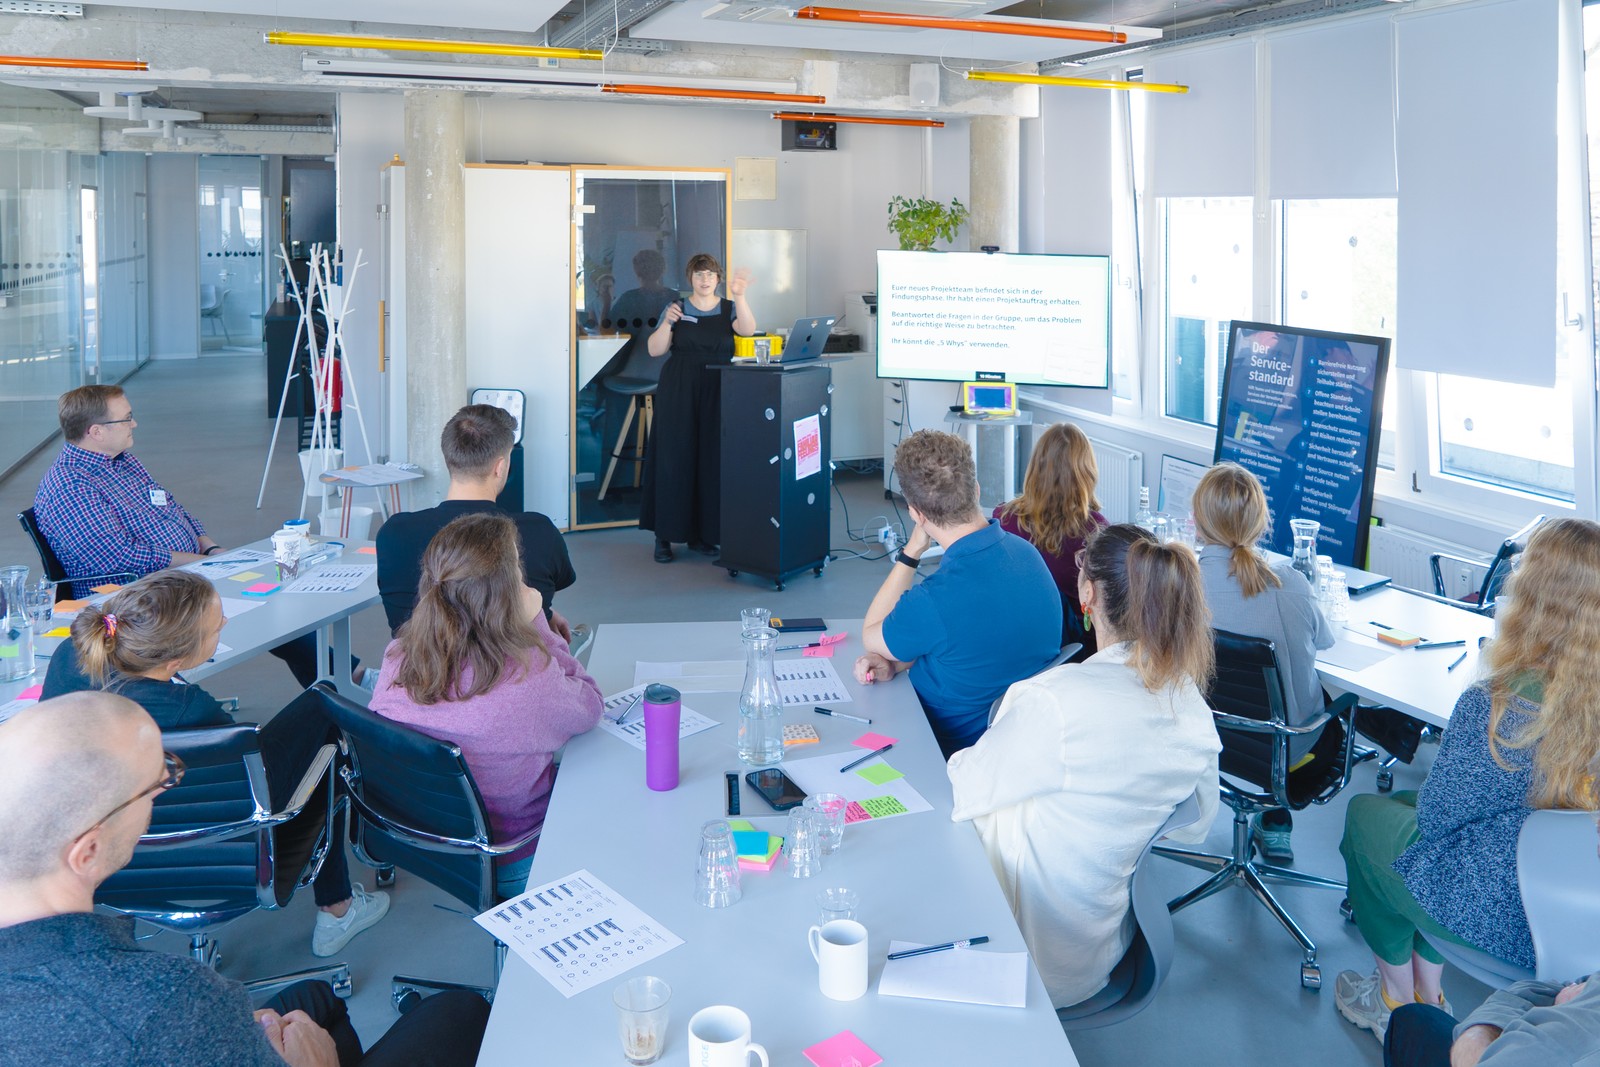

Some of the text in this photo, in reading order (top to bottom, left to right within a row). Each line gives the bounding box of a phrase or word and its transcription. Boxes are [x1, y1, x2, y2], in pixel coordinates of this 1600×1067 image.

[892, 294, 944, 302] Findungsphase.
[996, 296, 1048, 306] Projektauftrag
[1252, 341, 1270, 354] Der
[1250, 355, 1292, 372] Service-
[1318, 360, 1346, 368] Barrierefreie
[1248, 370, 1294, 387] standard
[1318, 369, 1346, 378] sicherstellen
[1316, 378, 1352, 389] Teilhabe stärken
[1330, 393, 1353, 402] Standards
[1314, 399, 1334, 408] beachten
[1344, 405, 1362, 414] Schnitt-
[1328, 411, 1357, 422] bereitstellen
[1311, 421, 1338, 432] Datenschutz
[1338, 428, 1360, 436] umsetzen
[1320, 432, 1336, 440] Risiken
[1336, 436, 1360, 446] reduzieren
[1308, 442, 1330, 453] Sicherheit
[1258, 452, 1282, 463] beschreiben
[1316, 454, 1338, 464] Vertrauen
[1338, 460, 1358, 470] schaffen
[1258, 462, 1280, 472] bestimmen
[1318, 468, 1334, 476] Source
[1334, 472, 1350, 480] nutzen
[1314, 476, 1325, 484] Code
[1326, 480, 1338, 488] teilen
[1303, 486, 1332, 500] Verfügbarkeit
[1300, 504, 1320, 515] beheben
[1302, 496, 1318, 504] sichern
[1328, 503, 1351, 515] Störungen
[1317, 534, 1342, 546] rgebnissen
